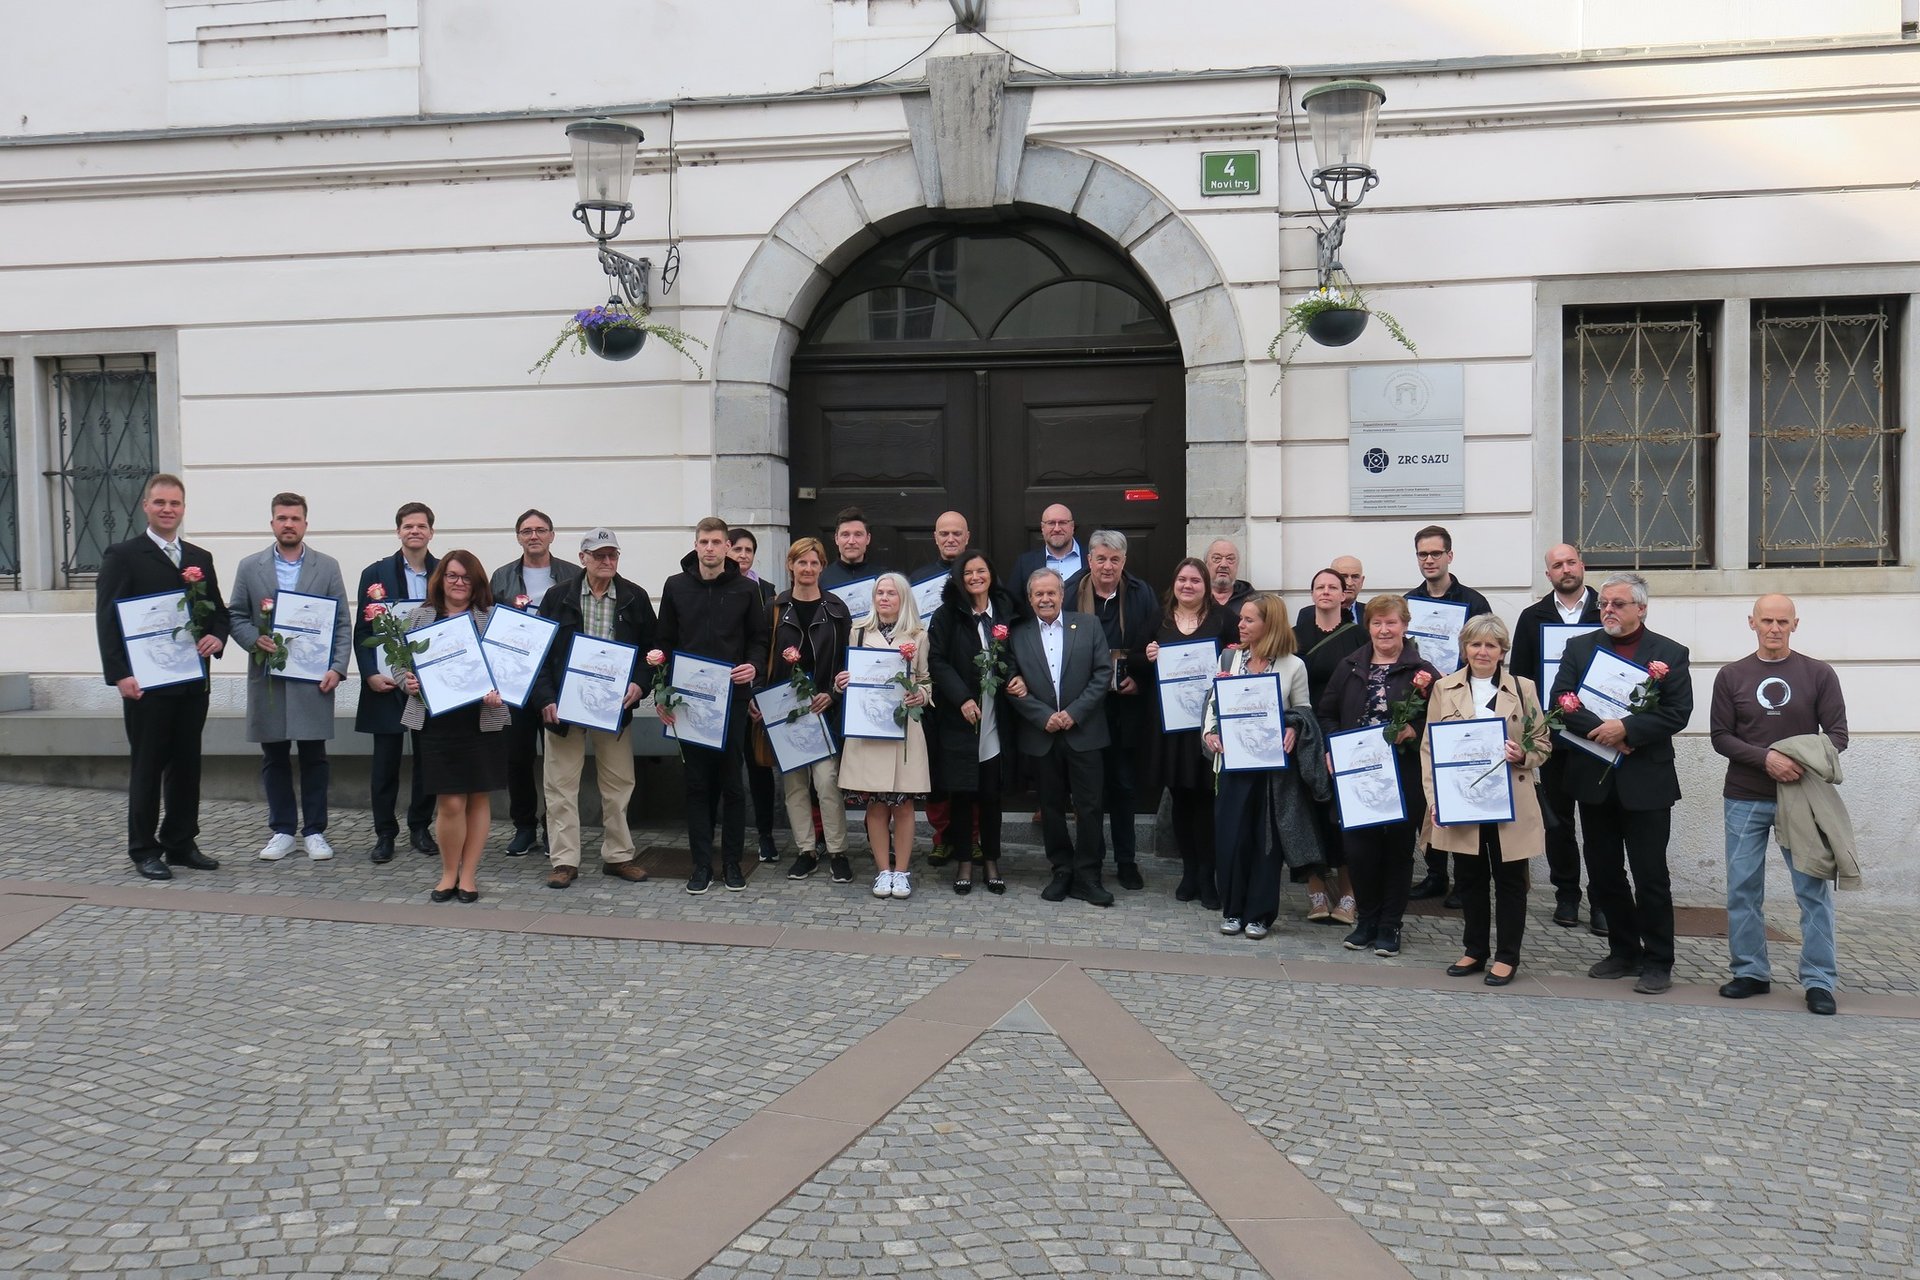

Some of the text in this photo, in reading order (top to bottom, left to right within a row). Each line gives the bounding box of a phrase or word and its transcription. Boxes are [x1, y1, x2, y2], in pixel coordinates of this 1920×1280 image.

[1223, 158, 1236, 177] 4
[1210, 179, 1250, 191] Novi trg
[1398, 454, 1450, 465] ZRC SAZU
